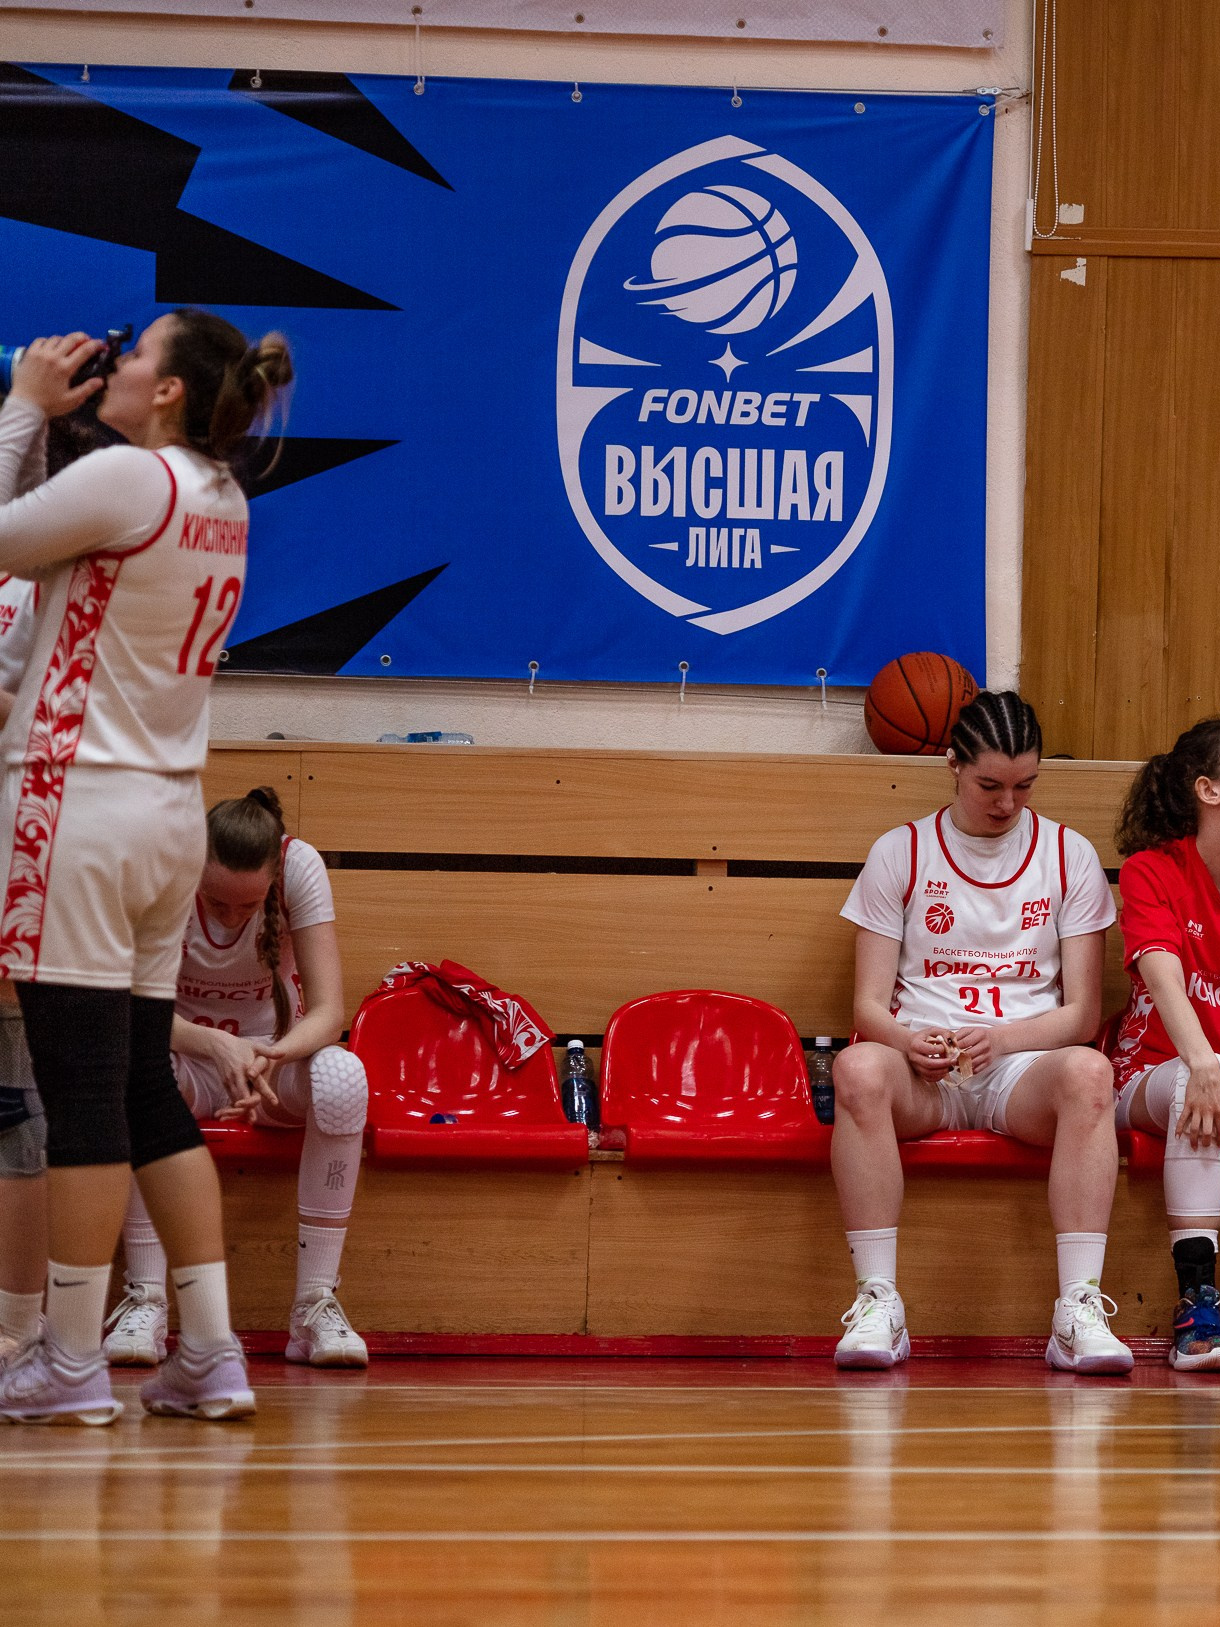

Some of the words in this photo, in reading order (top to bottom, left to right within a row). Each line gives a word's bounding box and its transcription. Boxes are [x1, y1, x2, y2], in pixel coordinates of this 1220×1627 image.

[638, 388, 821, 427] FONBET
[604, 444, 844, 522] ВЫСШАЯ
[685, 526, 763, 569] ЛИГА
[177, 575, 241, 677] 12
[924, 888, 950, 896] SPORT
[1021, 897, 1051, 916] FON
[1020, 912, 1051, 931] BET
[933, 946, 1015, 959] БАСКЕТБОЛЬНЫЙ
[1016, 947, 1038, 957] КЛУБ
[958, 985, 1004, 1018] 21
